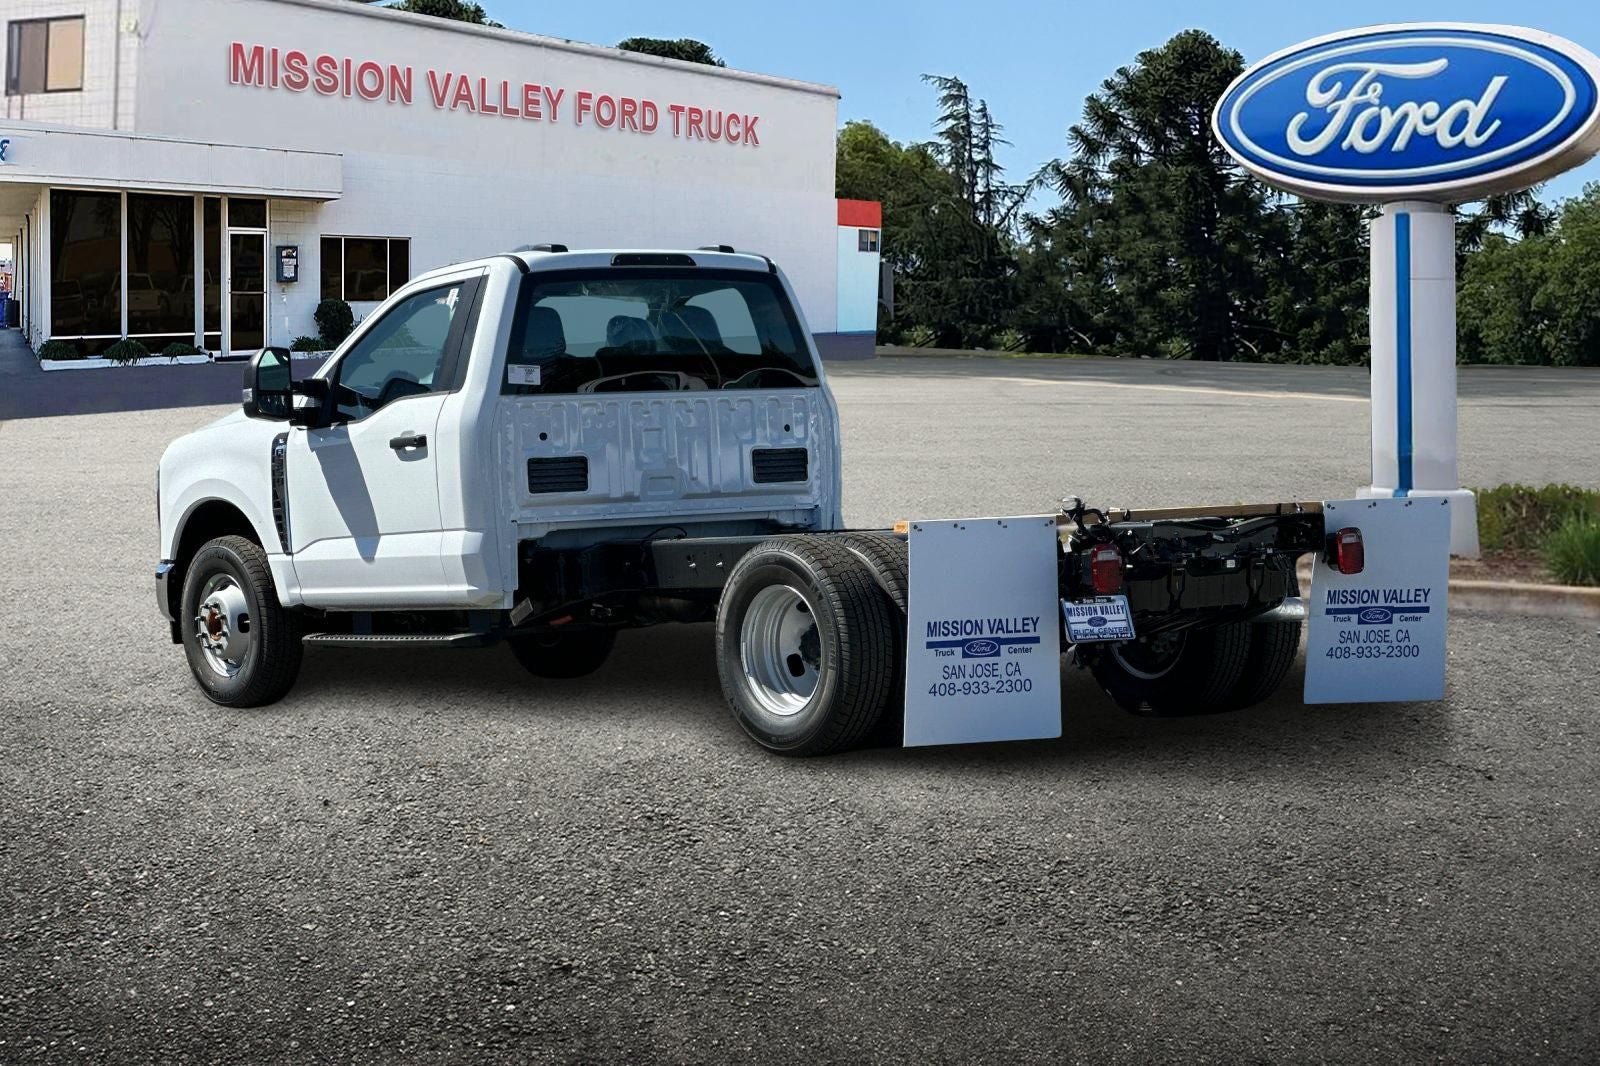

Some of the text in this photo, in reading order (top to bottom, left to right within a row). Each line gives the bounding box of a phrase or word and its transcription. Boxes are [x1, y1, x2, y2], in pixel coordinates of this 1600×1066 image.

[229, 41, 761, 146] MISSION VALLEY FORD TRUCK
[1285, 57, 1510, 156] Ford
[1326, 588, 1431, 605] MISSION VALLEY
[1066, 604, 1125, 617] MISSION VALLEY
[1366, 610, 1386, 620] Ford
[1333, 615, 1423, 623] Truck Center
[926, 616, 1040, 638] MISSION VALLEY
[1339, 629, 1411, 644] SAN JOSE, CA
[934, 646, 1033, 657] Truck Center
[970, 642, 993, 652] Ford
[1326, 644, 1420, 659] 408-933-2300
[942, 661, 1022, 680] SAN JOSE, CA
[928, 678, 1032, 697] 408-933-2300
